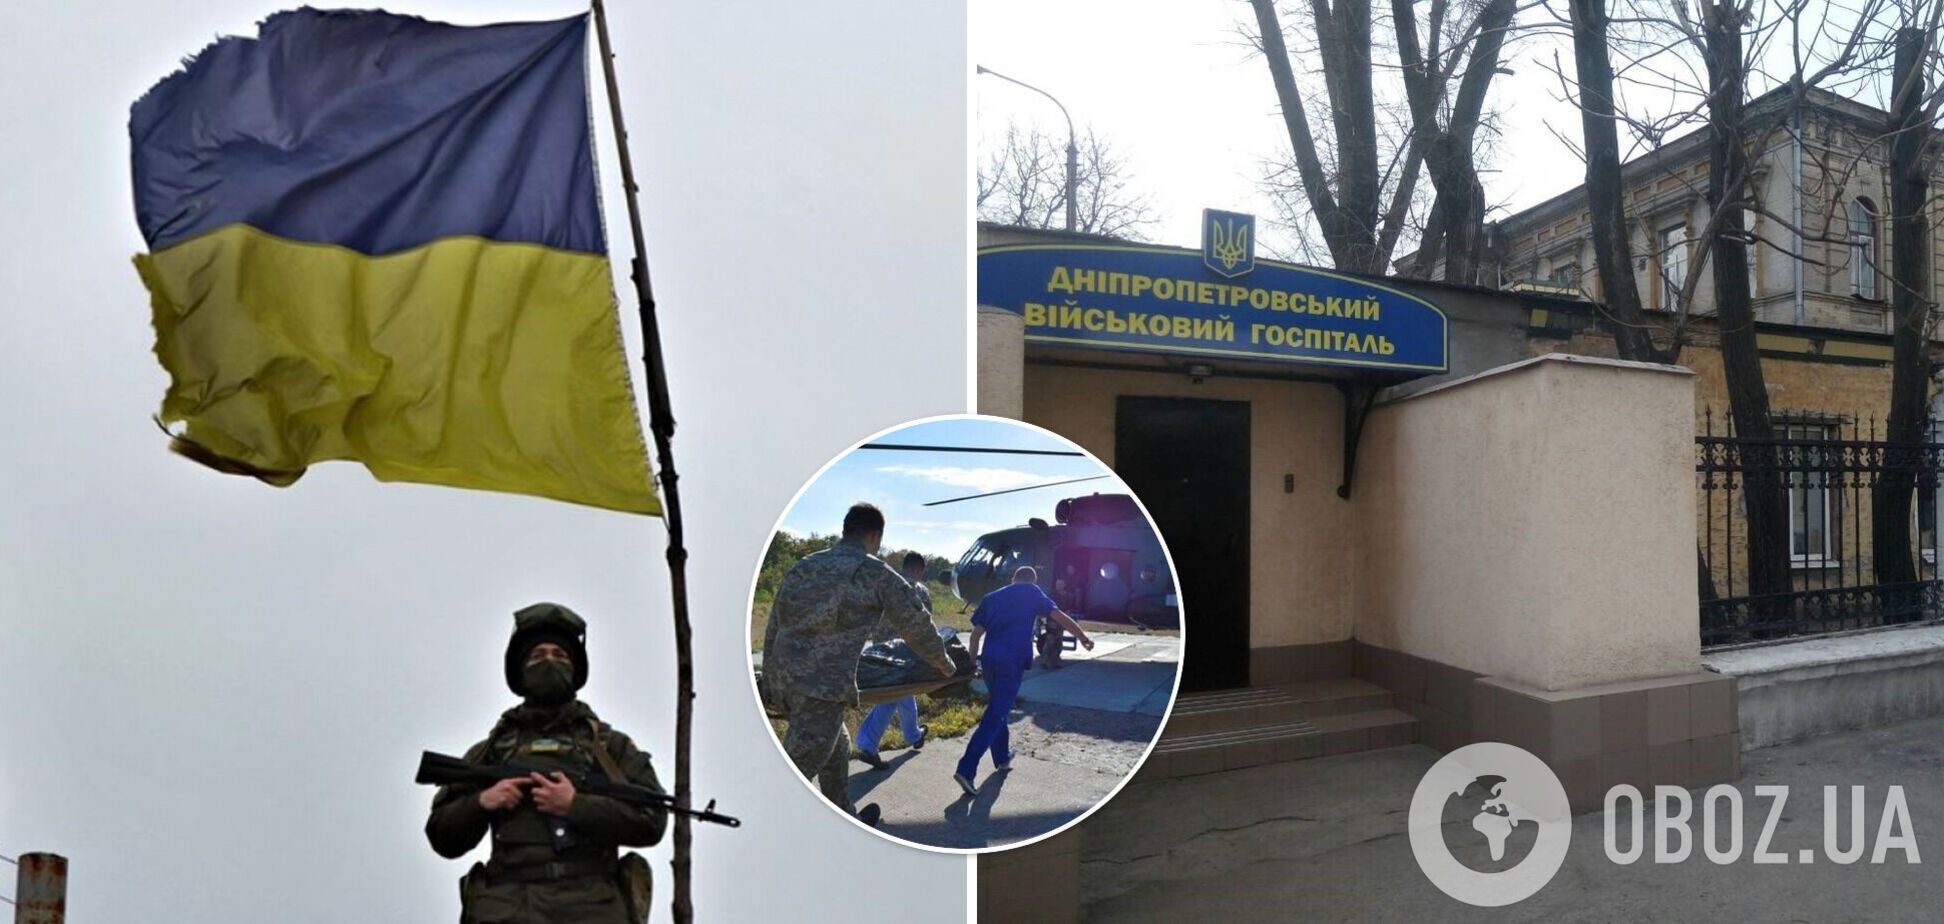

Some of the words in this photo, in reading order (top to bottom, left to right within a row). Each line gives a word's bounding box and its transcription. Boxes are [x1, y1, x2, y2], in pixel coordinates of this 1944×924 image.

[1047, 265, 1380, 321] ДНІПРОПЕТРОВСЬКИЙ
[1024, 299, 1234, 342] ВІЙСЬКОВИЙ
[1251, 323, 1395, 355] ГОСПІТАЛЬ
